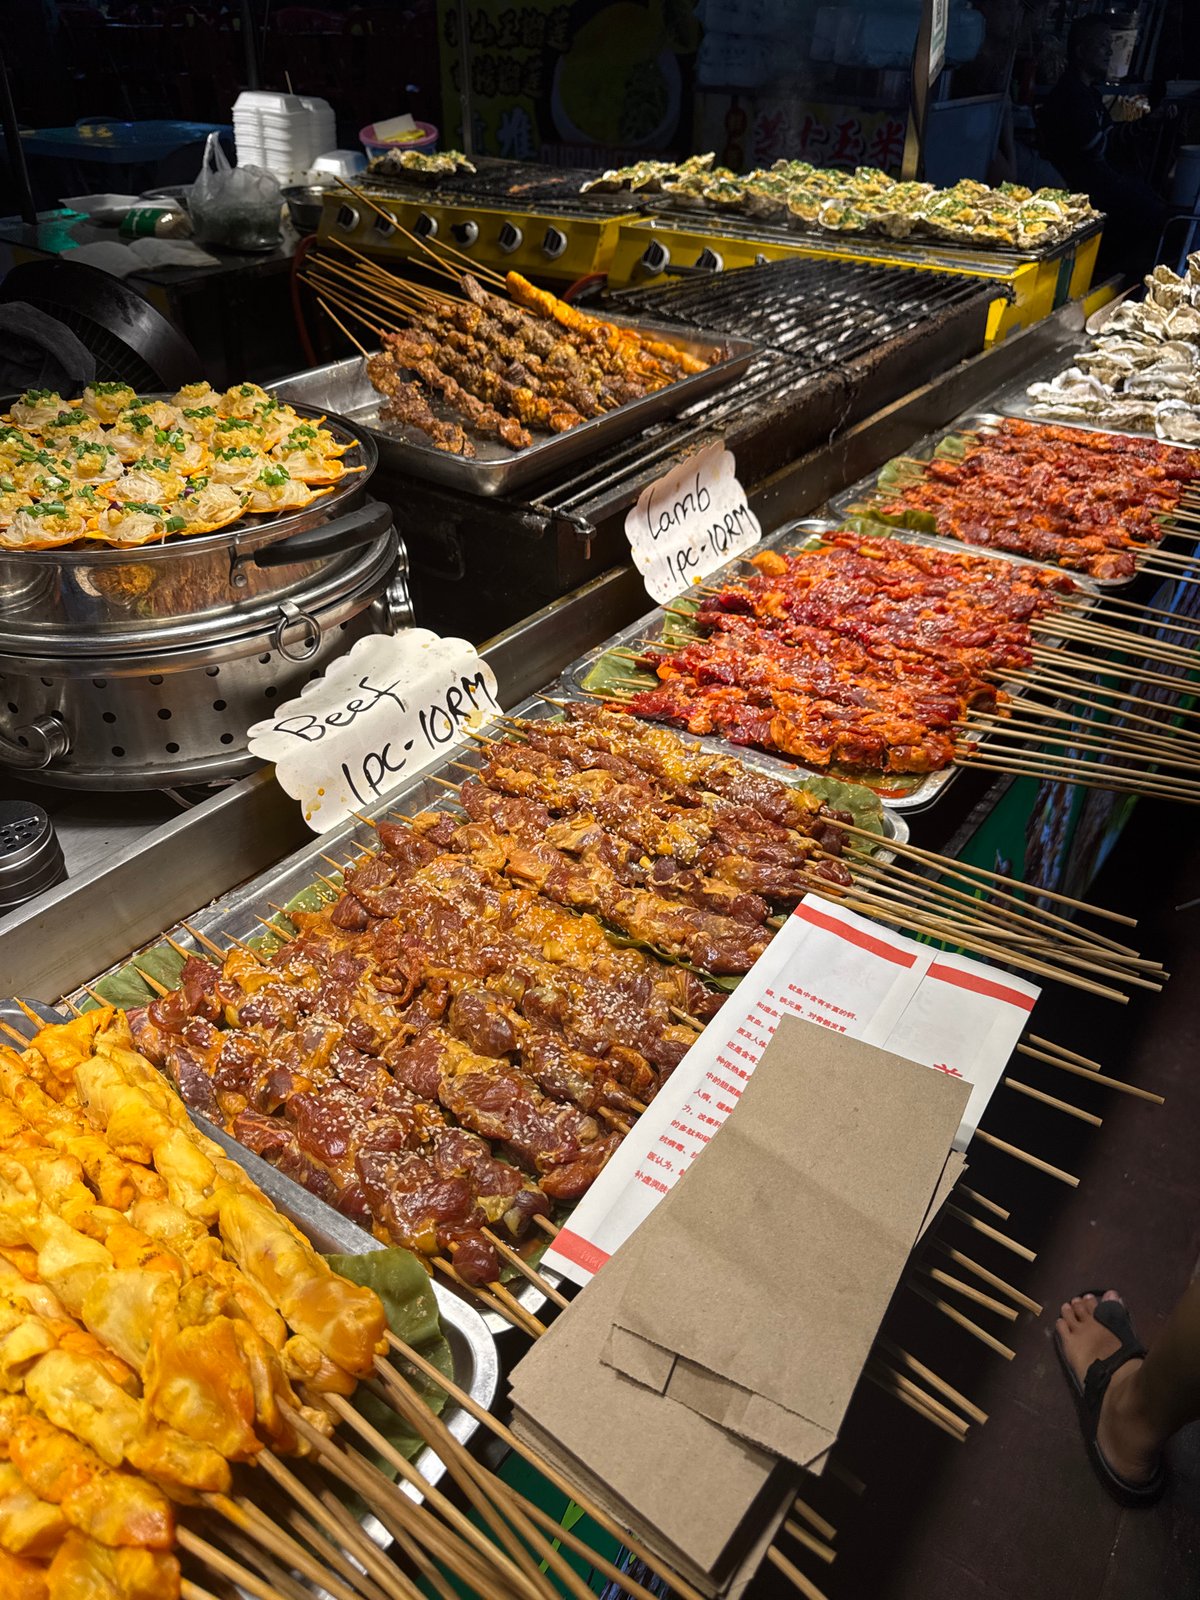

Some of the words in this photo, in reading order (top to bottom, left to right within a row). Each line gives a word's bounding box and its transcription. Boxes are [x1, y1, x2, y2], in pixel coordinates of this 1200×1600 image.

[647, 471, 711, 540] Lamb
[273, 676, 406, 742] Beef
[726, 1041, 760, 1065] 还是含有
